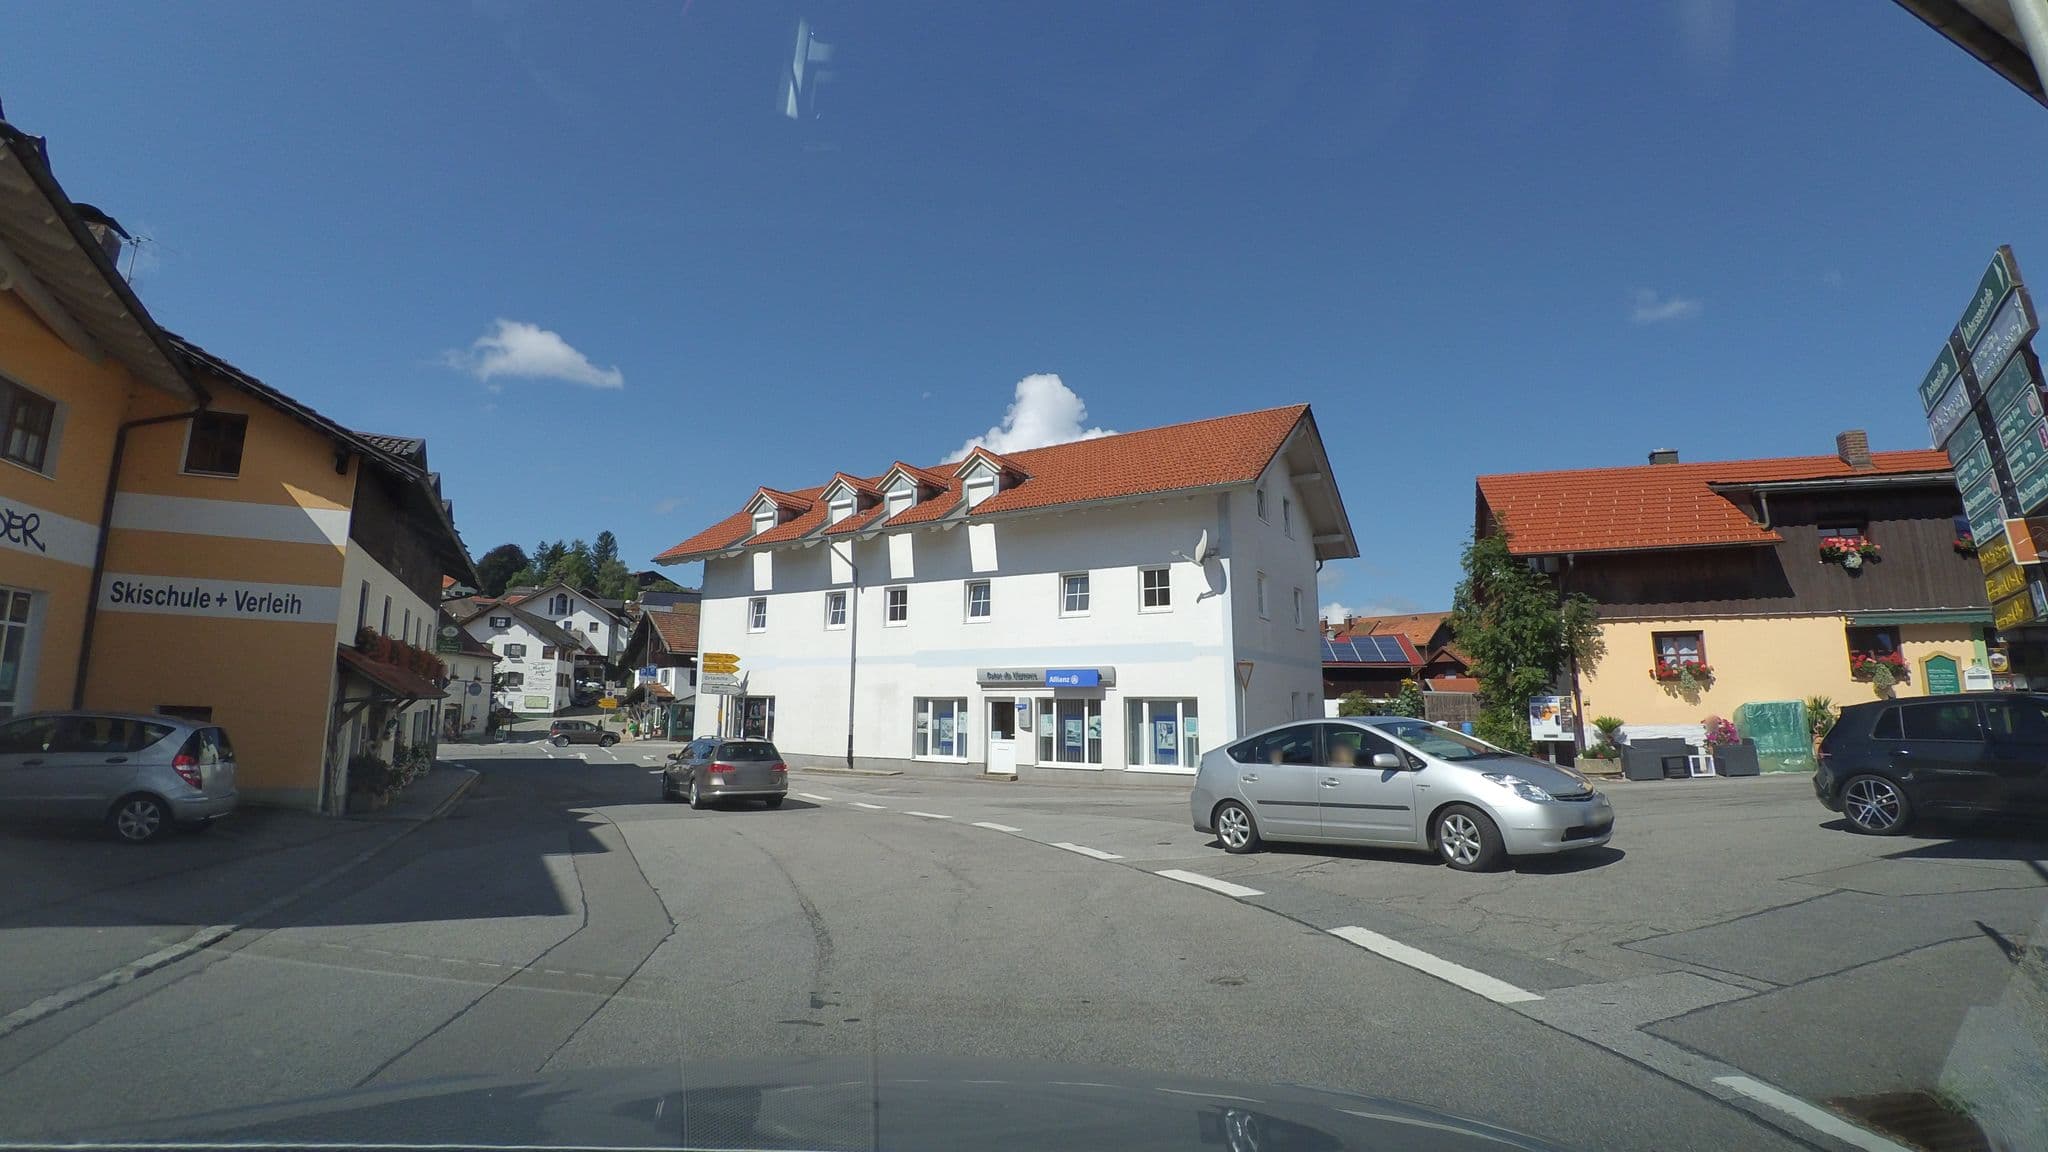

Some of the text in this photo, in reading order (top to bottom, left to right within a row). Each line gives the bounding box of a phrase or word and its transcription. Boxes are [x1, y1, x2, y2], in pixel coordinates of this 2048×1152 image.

[110, 580, 302, 615] Skischule + Verleih
